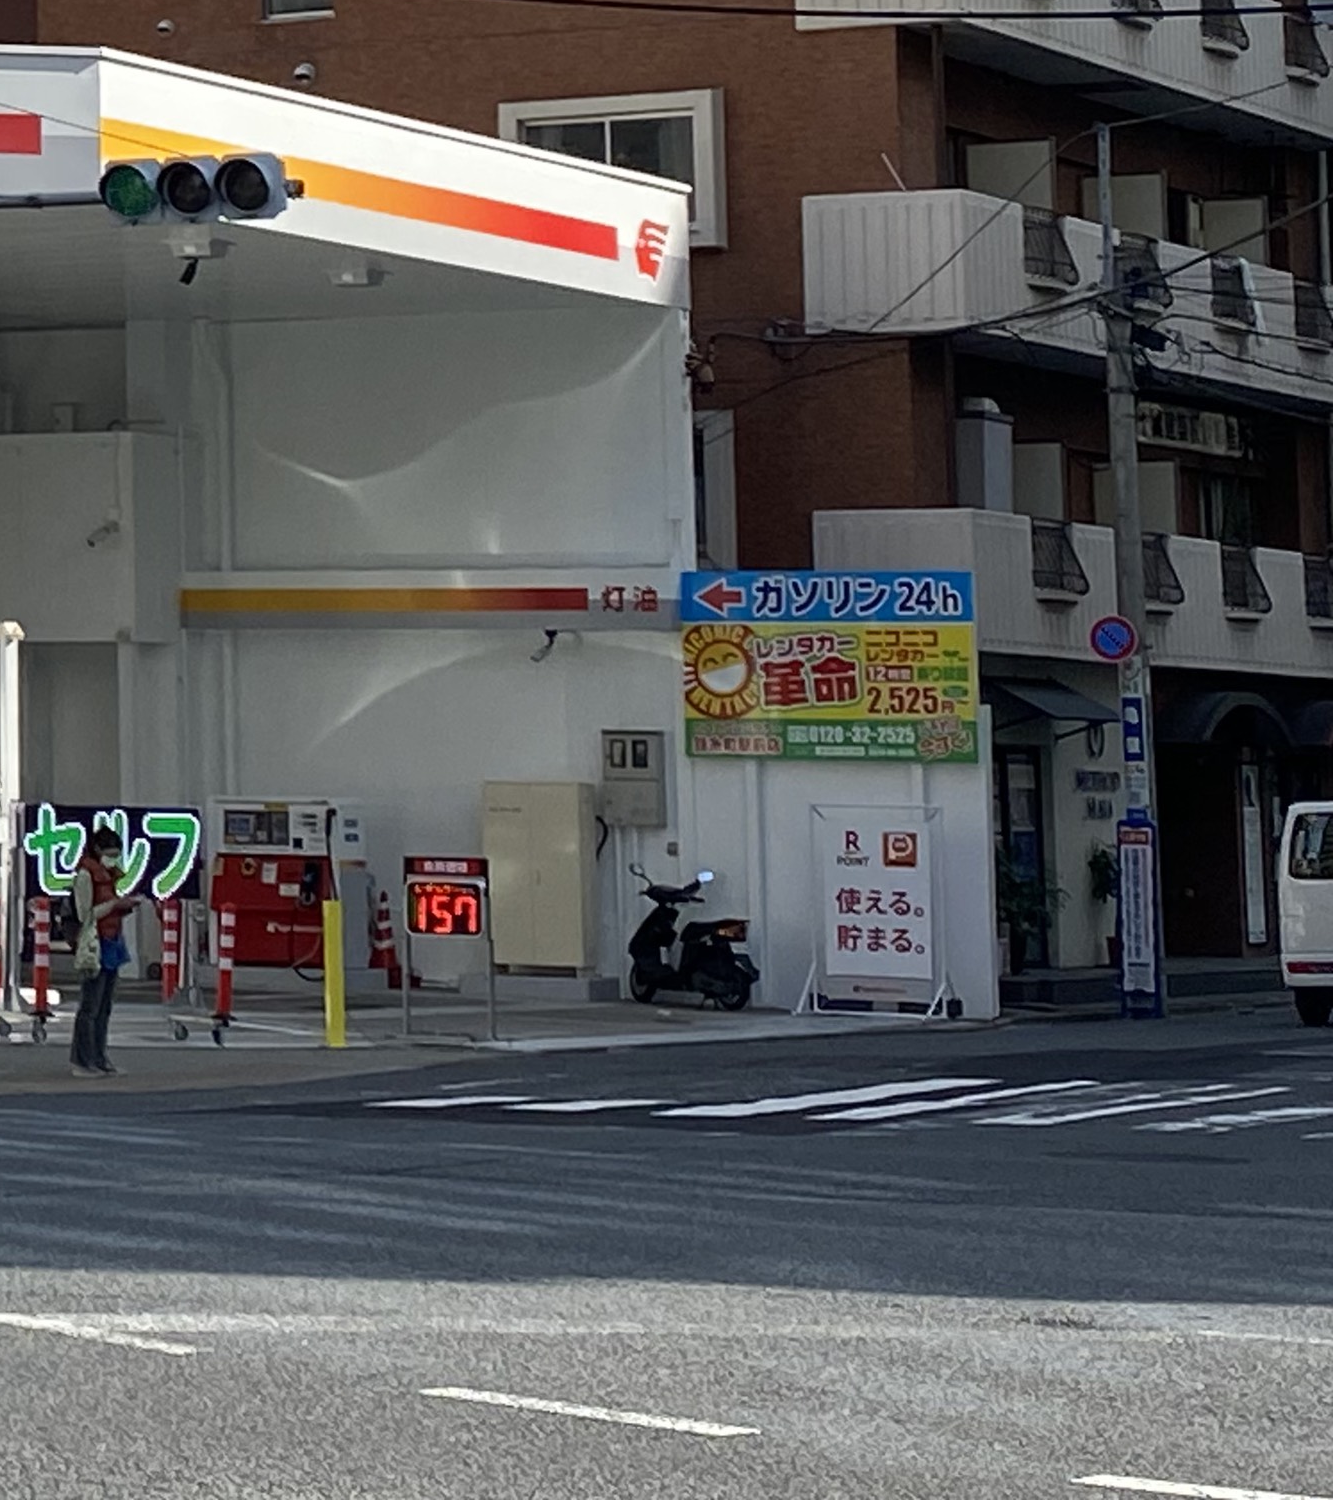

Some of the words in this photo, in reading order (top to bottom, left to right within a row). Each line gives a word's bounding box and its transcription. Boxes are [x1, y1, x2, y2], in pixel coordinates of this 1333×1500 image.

[601, 585, 660, 612] 灯油
[754, 576, 889, 617] ガソリン
[895, 578, 962, 615] 24h
[755, 635, 856, 659] レンタカー
[865, 630, 938, 647] ニコニコ
[865, 649, 940, 662] レンタカー
[759, 656, 859, 706] 革命
[845, 831, 861, 851] R
[418, 895, 478, 934] 157
[835, 887, 925, 918] 使える。
[836, 924, 926, 955] 貯まる。
